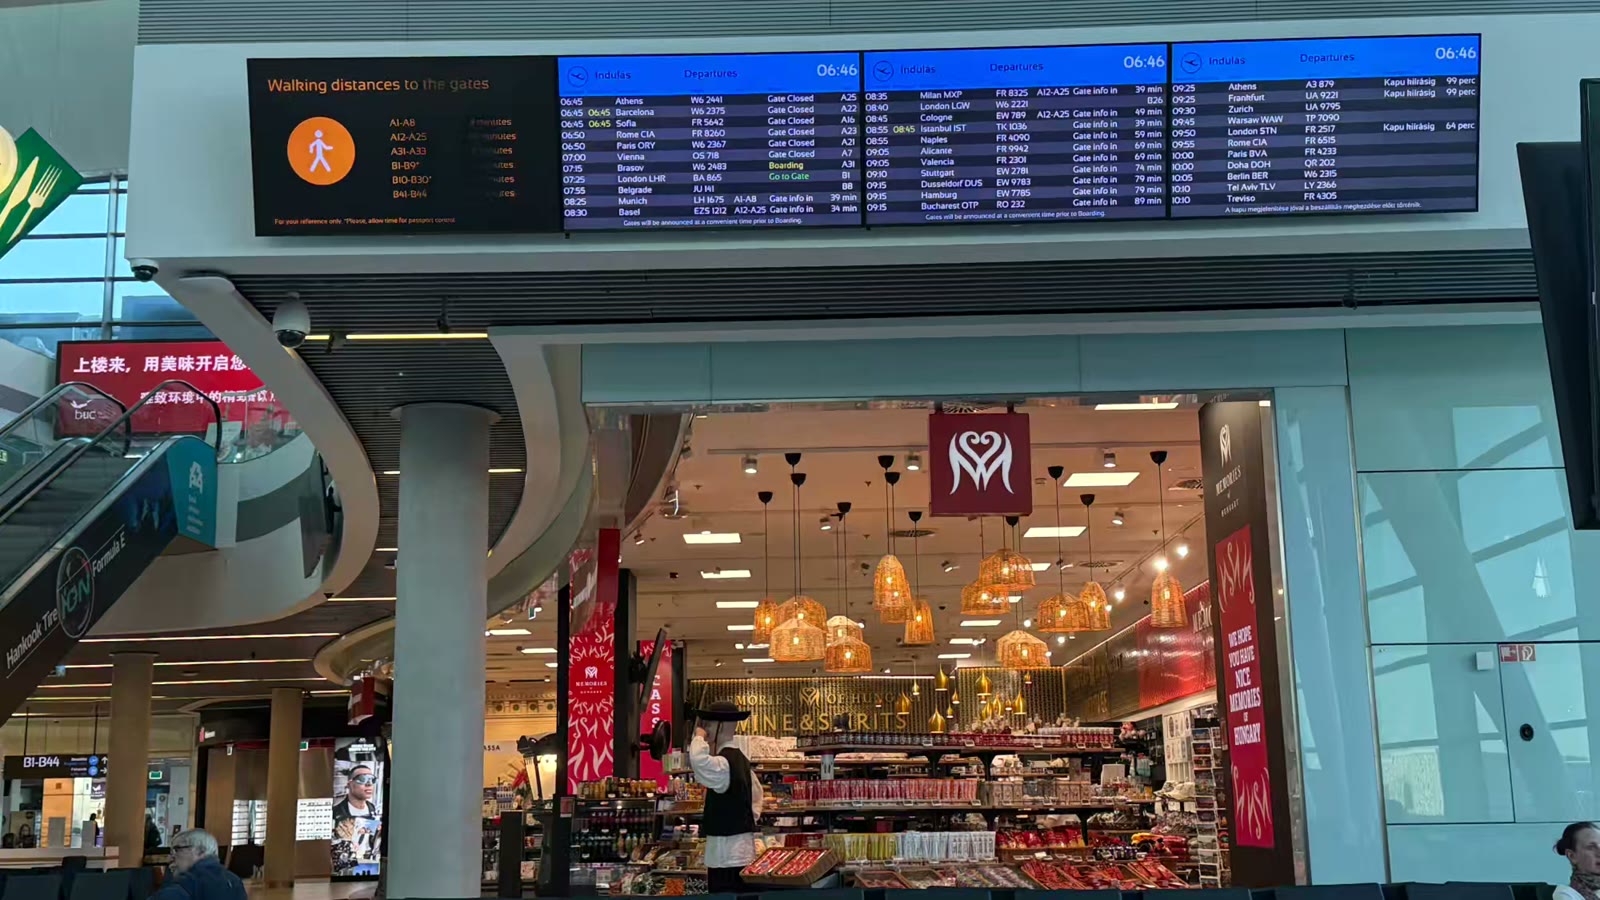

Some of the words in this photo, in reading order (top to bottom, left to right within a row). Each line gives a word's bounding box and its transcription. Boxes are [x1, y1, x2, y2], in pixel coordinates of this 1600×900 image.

[1300, 54, 1354, 62] Departures
[1435, 47, 1476, 59] 06:46
[684, 69, 738, 79] Departures
[817, 64, 857, 76] 06:46
[990, 64, 1043, 72] Departures
[1124, 56, 1164, 68] 06:46
[268, 78, 327, 94] Walking
[331, 78, 400, 92] distances
[404, 80, 418, 91] to
[423, 79, 446, 90] the
[450, 79, 490, 92] gates
[390, 118, 416, 127] A1-A8
[390, 133, 427, 141] A12-A25
[391, 147, 427, 156] A31-A33
[393, 190, 427, 198] B41-B44
[92, 540, 120, 577] Formula
[120, 531, 126, 549] E
[7, 622, 42, 669] Hankook
[42, 606, 58, 630] Tire
[1228, 630, 1237, 648] WE
[1237, 625, 1252, 644] HOPE
[1228, 650, 1240, 668] YOU
[1240, 645, 1255, 664] HAVE
[1235, 667, 1251, 688] NICE
[1229, 687, 1261, 712] MEMORIES
[1234, 723, 1260, 745] HUNGARY
[23, 756, 60, 768] B1-B44
